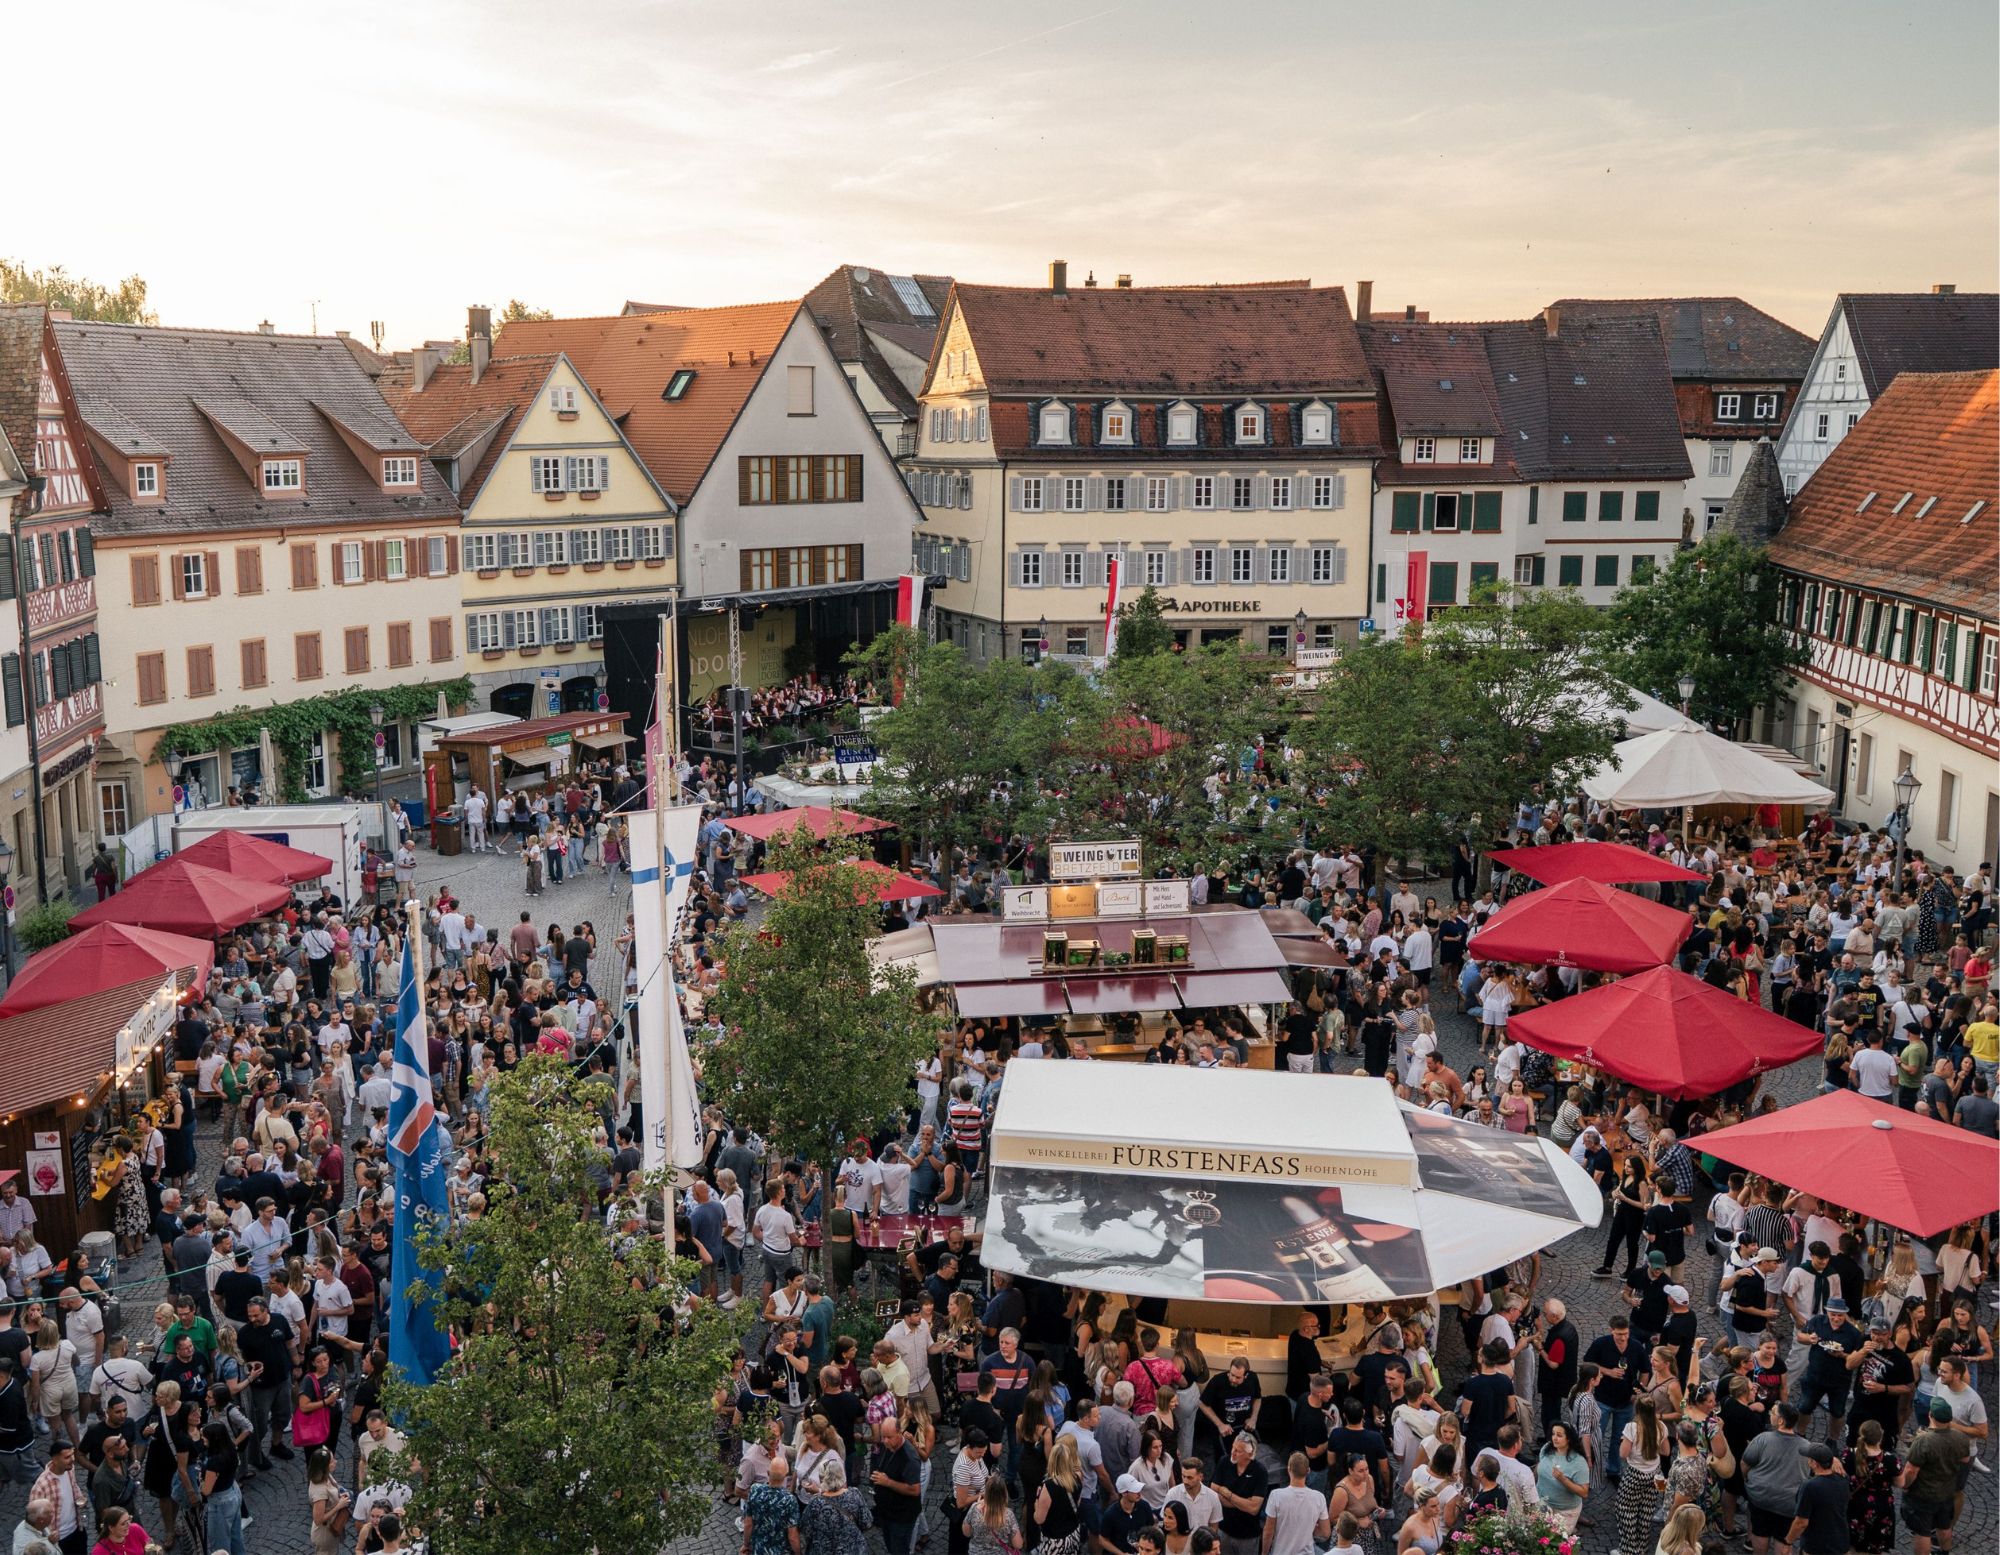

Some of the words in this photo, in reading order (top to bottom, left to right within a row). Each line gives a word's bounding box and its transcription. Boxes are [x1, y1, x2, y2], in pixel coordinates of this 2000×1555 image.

[1181, 600, 1262, 612] APOTHEKE
[1028, 1148, 1108, 1161] WEINKELLEREI
[1112, 1145, 1301, 1176] FÜRSTENFASS
[1304, 1165, 1378, 1177] HOHENLOHE
